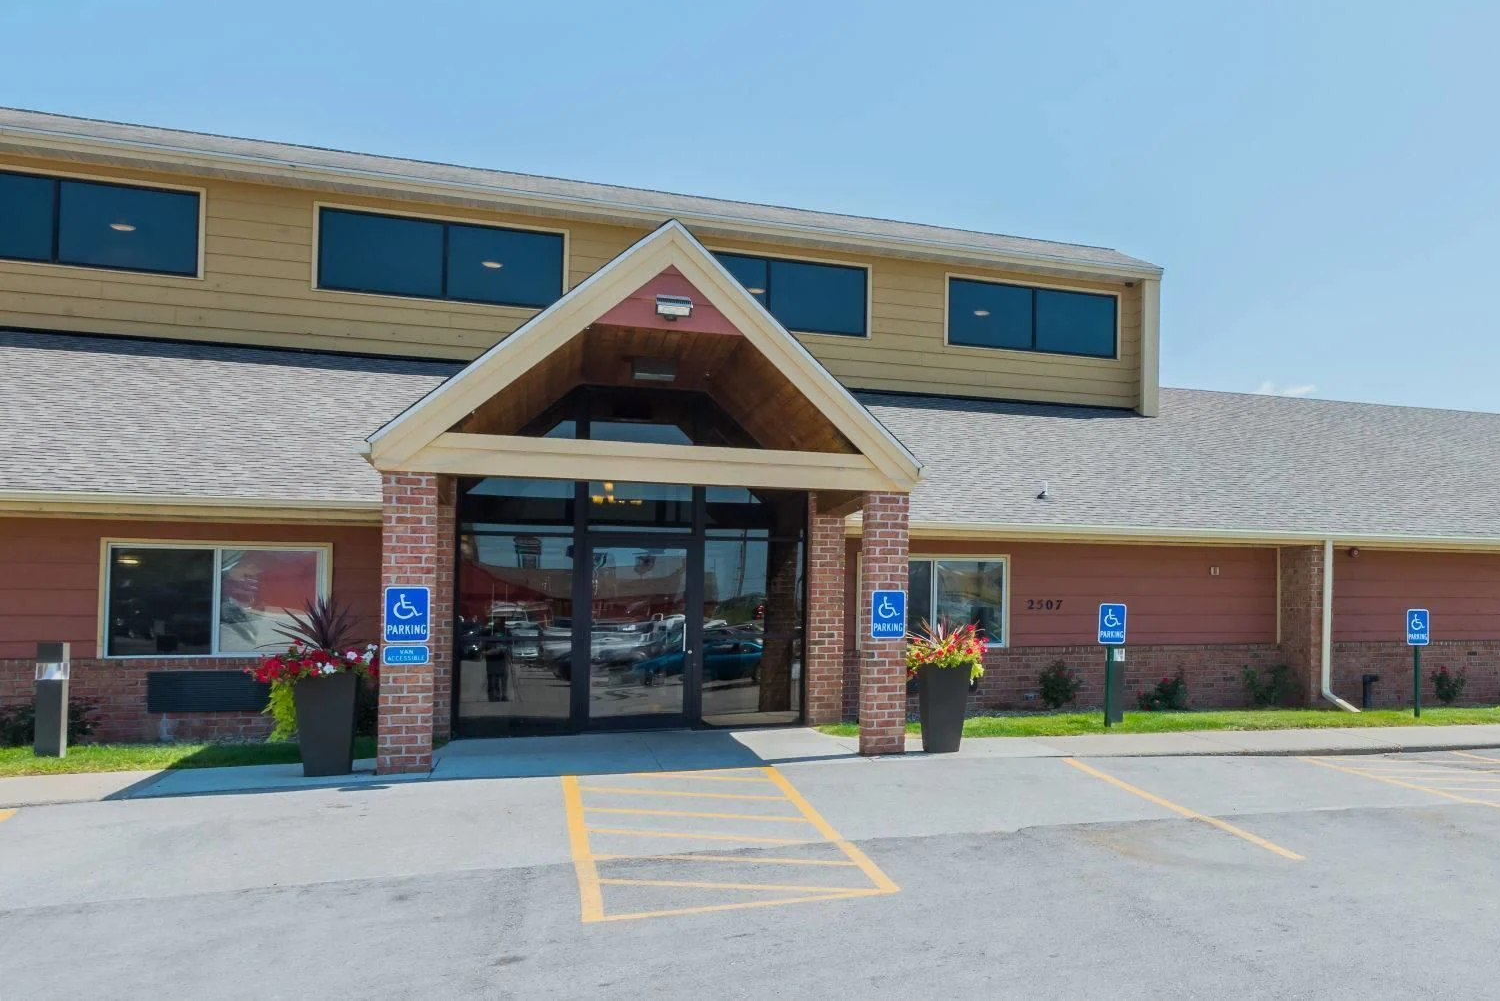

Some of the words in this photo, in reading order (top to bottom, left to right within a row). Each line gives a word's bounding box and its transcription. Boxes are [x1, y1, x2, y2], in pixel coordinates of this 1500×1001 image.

[1027, 599, 1063, 610] 2507
[387, 624, 427, 635] PARKING
[873, 622, 903, 632] PARKING
[1099, 630, 1124, 639] PARKING
